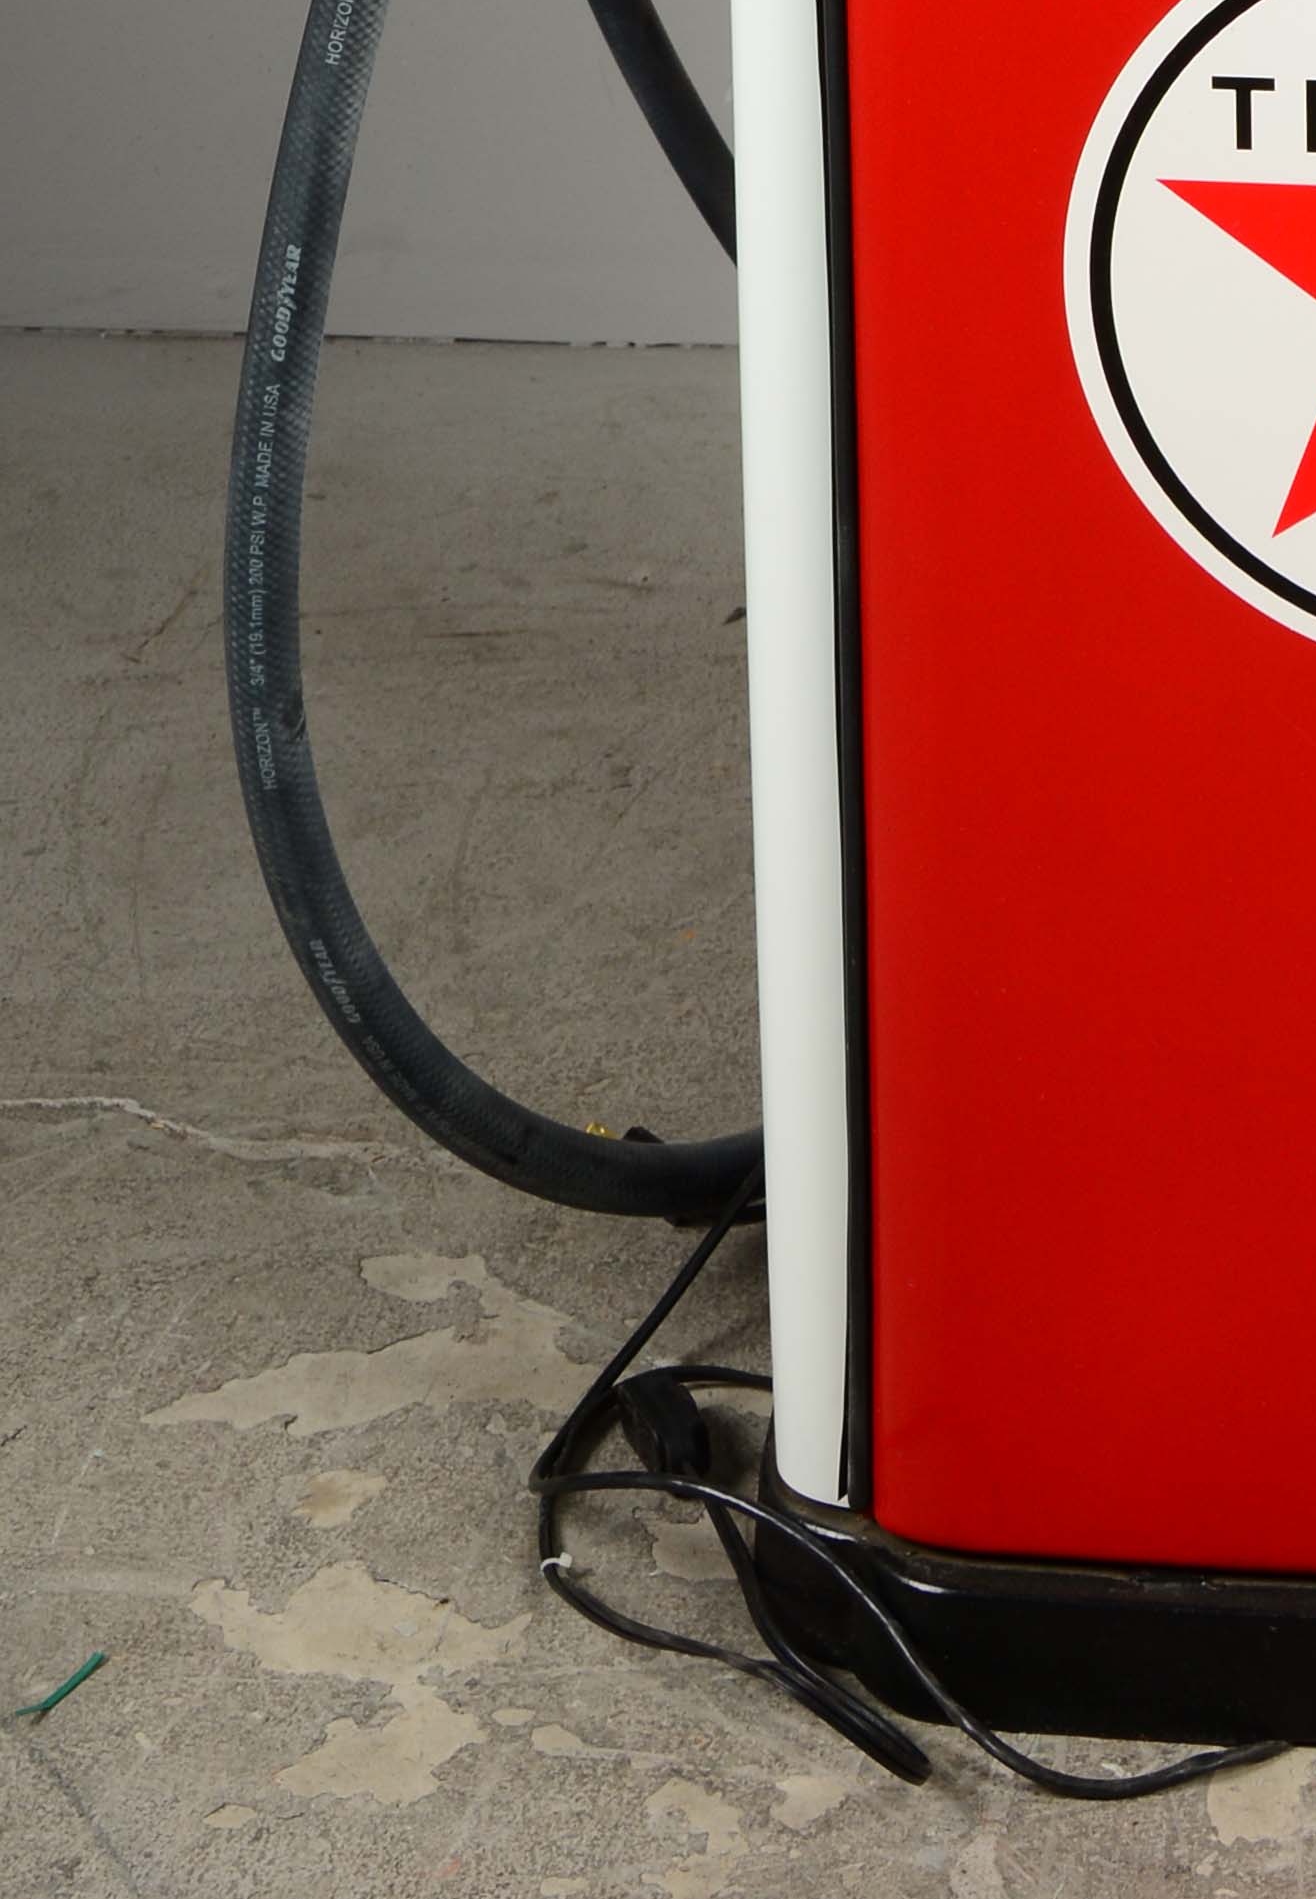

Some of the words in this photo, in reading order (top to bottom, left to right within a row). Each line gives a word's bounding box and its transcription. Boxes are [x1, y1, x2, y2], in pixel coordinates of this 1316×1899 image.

[271, 244, 302, 363] GOODYEAR
[264, 384, 281, 414] USA
[260, 421, 276, 438] IN
[255, 441, 273, 488] MADE
[250, 528, 265, 555] PSI
[249, 557, 263, 586] 200
